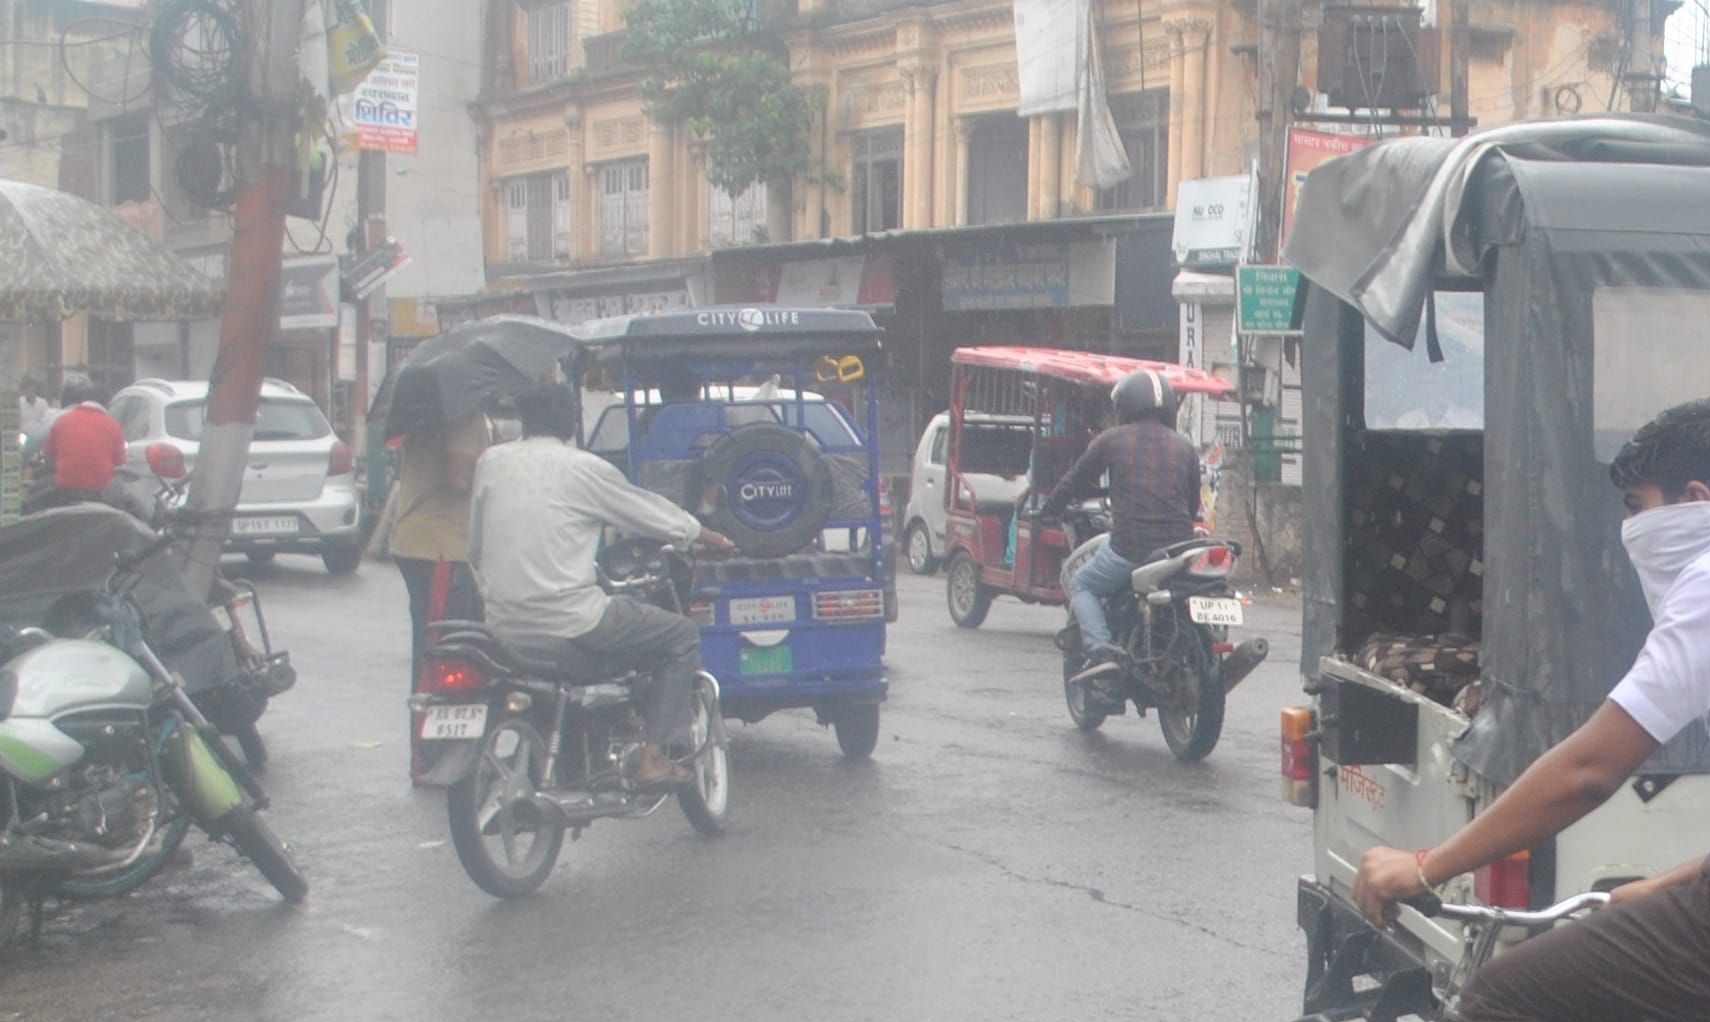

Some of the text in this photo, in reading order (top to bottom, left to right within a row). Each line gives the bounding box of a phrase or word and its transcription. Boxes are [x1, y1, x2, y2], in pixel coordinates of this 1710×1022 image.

[356, 98, 412, 127] शिविर
[697, 311, 800, 326] CITY LIFE
